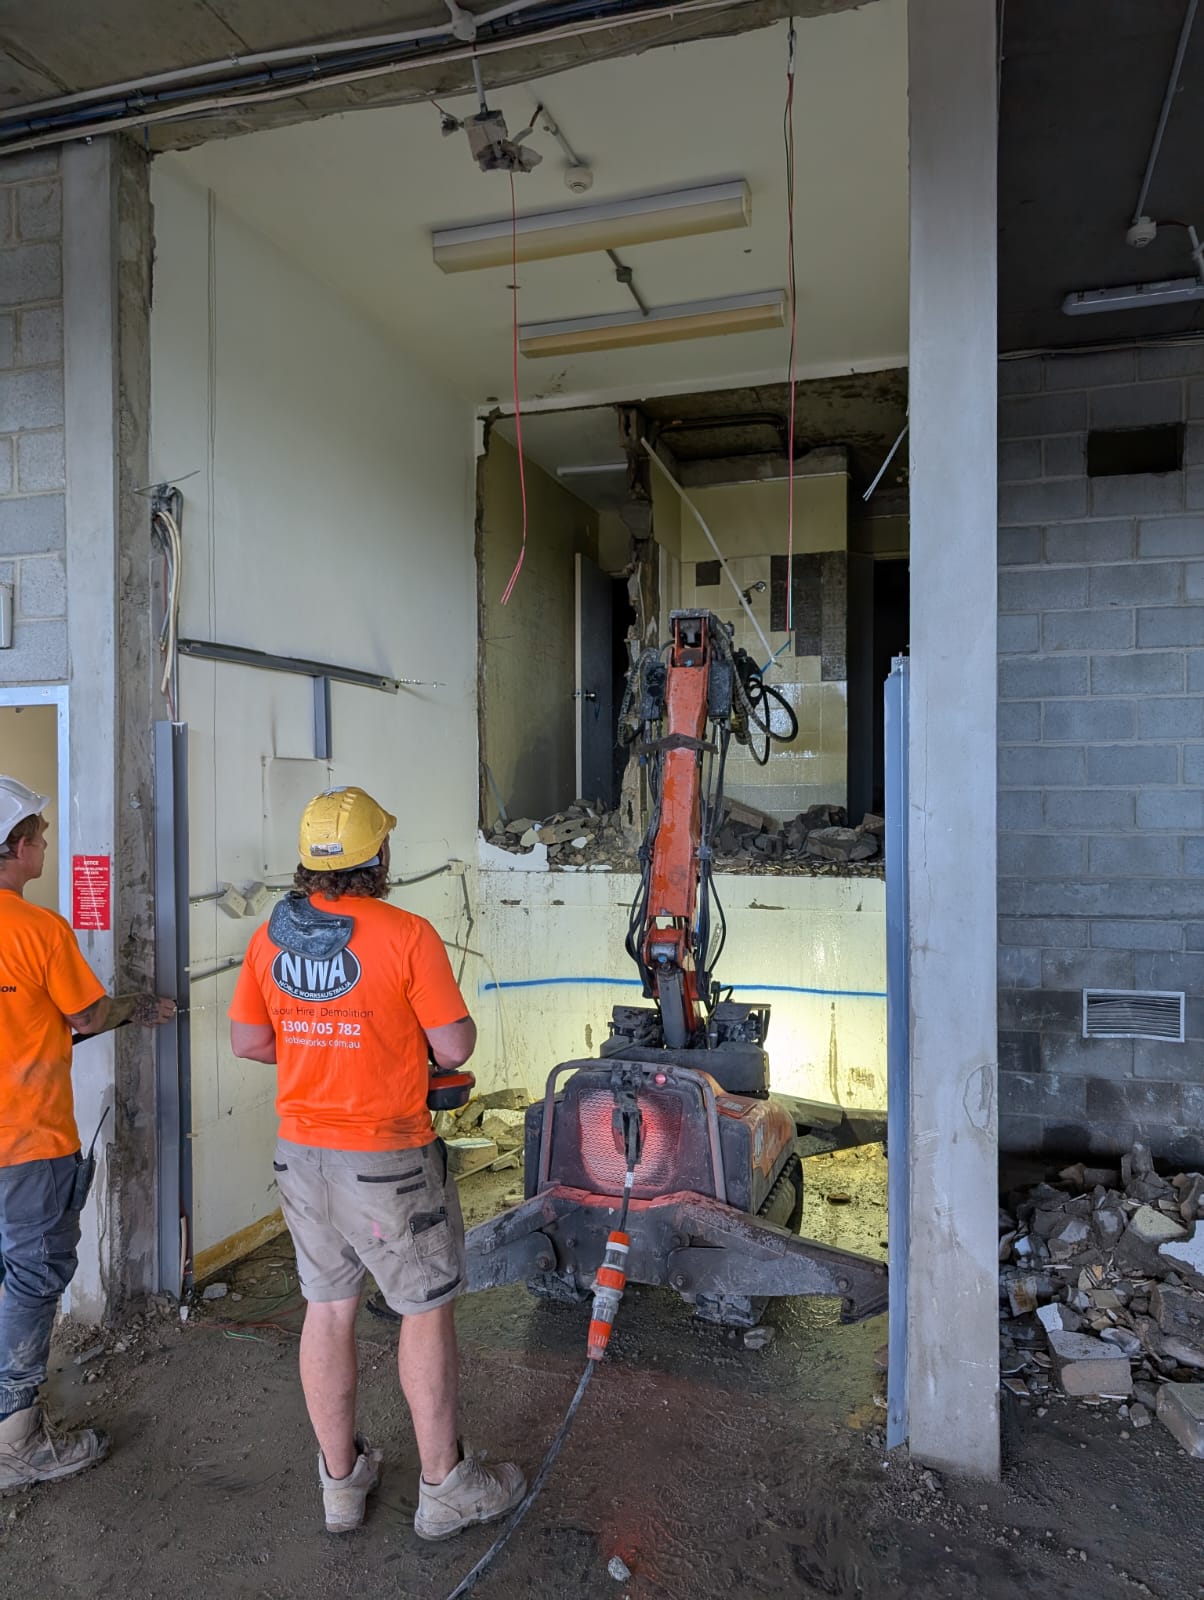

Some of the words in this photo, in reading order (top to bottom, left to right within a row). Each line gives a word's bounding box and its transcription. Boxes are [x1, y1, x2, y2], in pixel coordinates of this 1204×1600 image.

[281, 951, 347, 991] NWA
[0, 985, 17, 993] ON
[278, 980, 298, 994] NOBLE
[296, 1006, 315, 1016] Hire
[320, 1007, 374, 1018] Demolition
[280, 1020, 309, 1033] 1300
[310, 1022, 333, 1035] 705
[337, 1022, 361, 1036] 782
